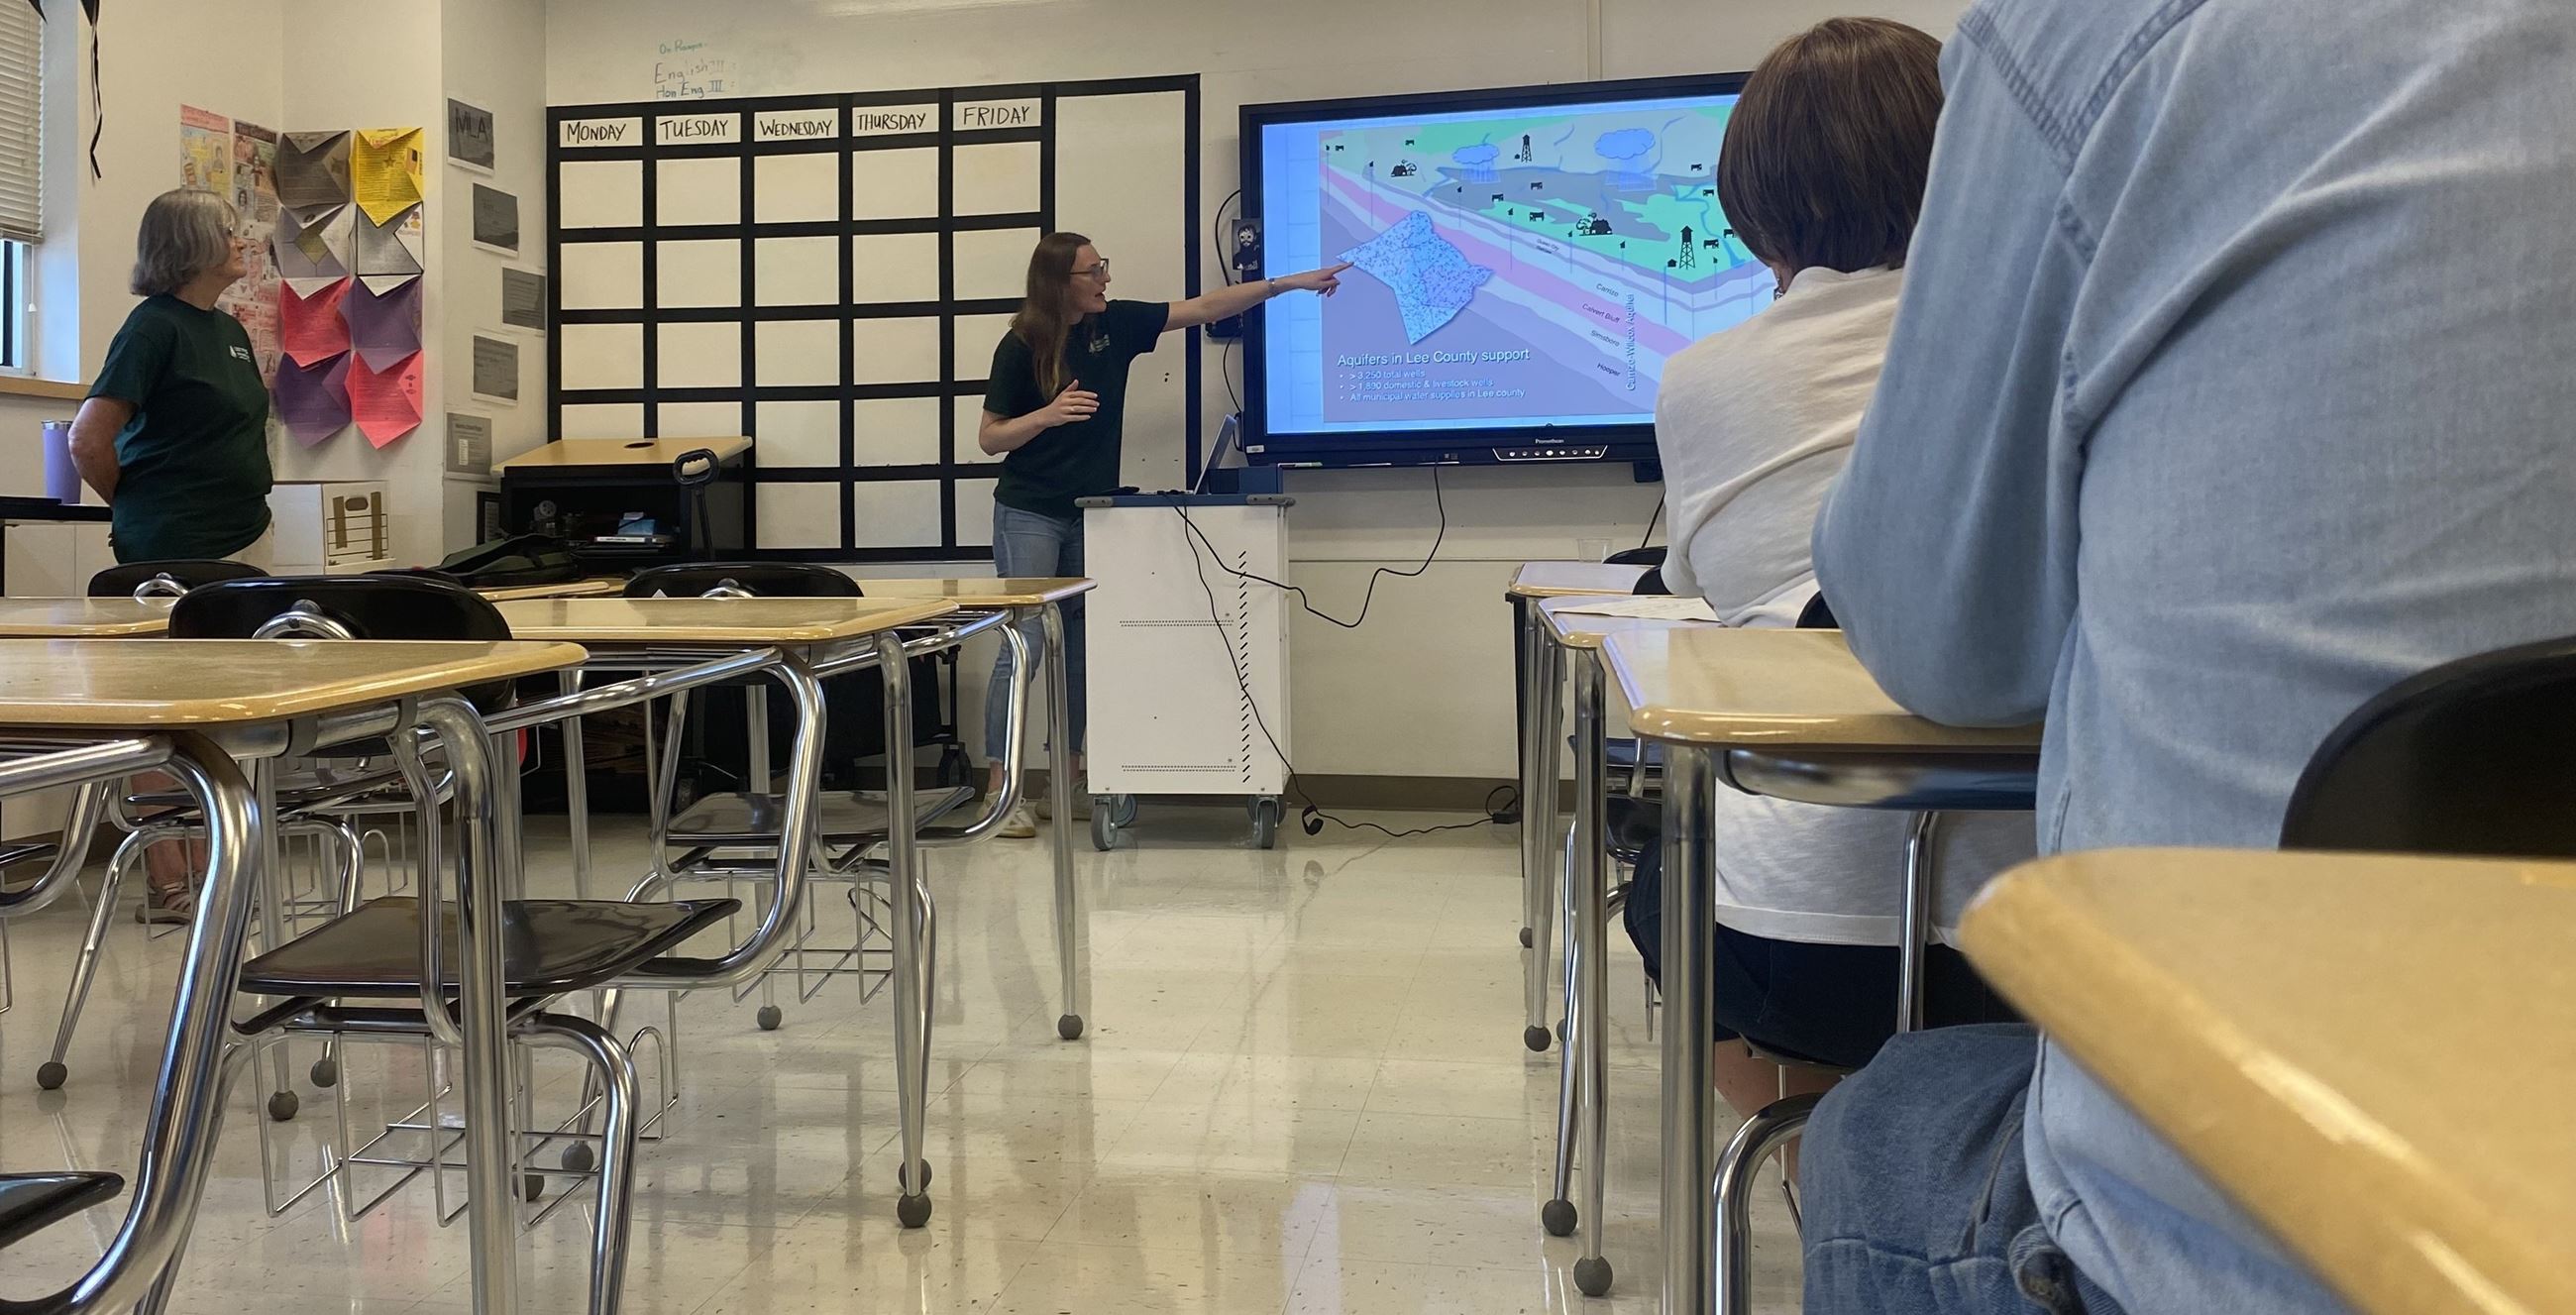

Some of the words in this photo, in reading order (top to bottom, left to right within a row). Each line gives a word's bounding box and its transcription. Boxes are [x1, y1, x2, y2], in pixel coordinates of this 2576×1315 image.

[681, 80, 704, 98] Eng
[454, 106, 488, 143] MLA
[856, 112, 926, 132] THURSDAY
[963, 105, 1030, 127] FRIDAY
[567, 121, 627, 145] MONDAY
[659, 118, 729, 141] TUESDAY
[759, 119, 833, 137] WEDNESDAY
[1595, 282, 1620, 298] Carrizo
[1581, 302, 1605, 318] Calvert
[1604, 311, 1621, 325] Bluff
[1590, 329, 1621, 347] Simsboro
[1337, 354, 1389, 369] Aquifers
[1391, 353, 1403, 365] in
[1406, 351, 1431, 365] Lee
[1433, 349, 1479, 367] County
[1481, 348, 1531, 364] support
[1383, 370, 1402, 380] total
[1403, 369, 1427, 379] wells
[1596, 362, 1621, 377] Hooper
[1383, 380, 1423, 390] domestic
[1423, 380, 1431, 389] &
[1433, 379, 1470, 389] livestock
[1471, 378, 1494, 387] wells
[1349, 392, 1361, 402] All
[1362, 391, 1404, 403] municipal
[1404, 391, 1430, 401] water
[1431, 389, 1466, 403] supplies
[1467, 389, 1476, 399] in
[1477, 388, 1495, 398] Lee
[1496, 387, 1527, 399] county
